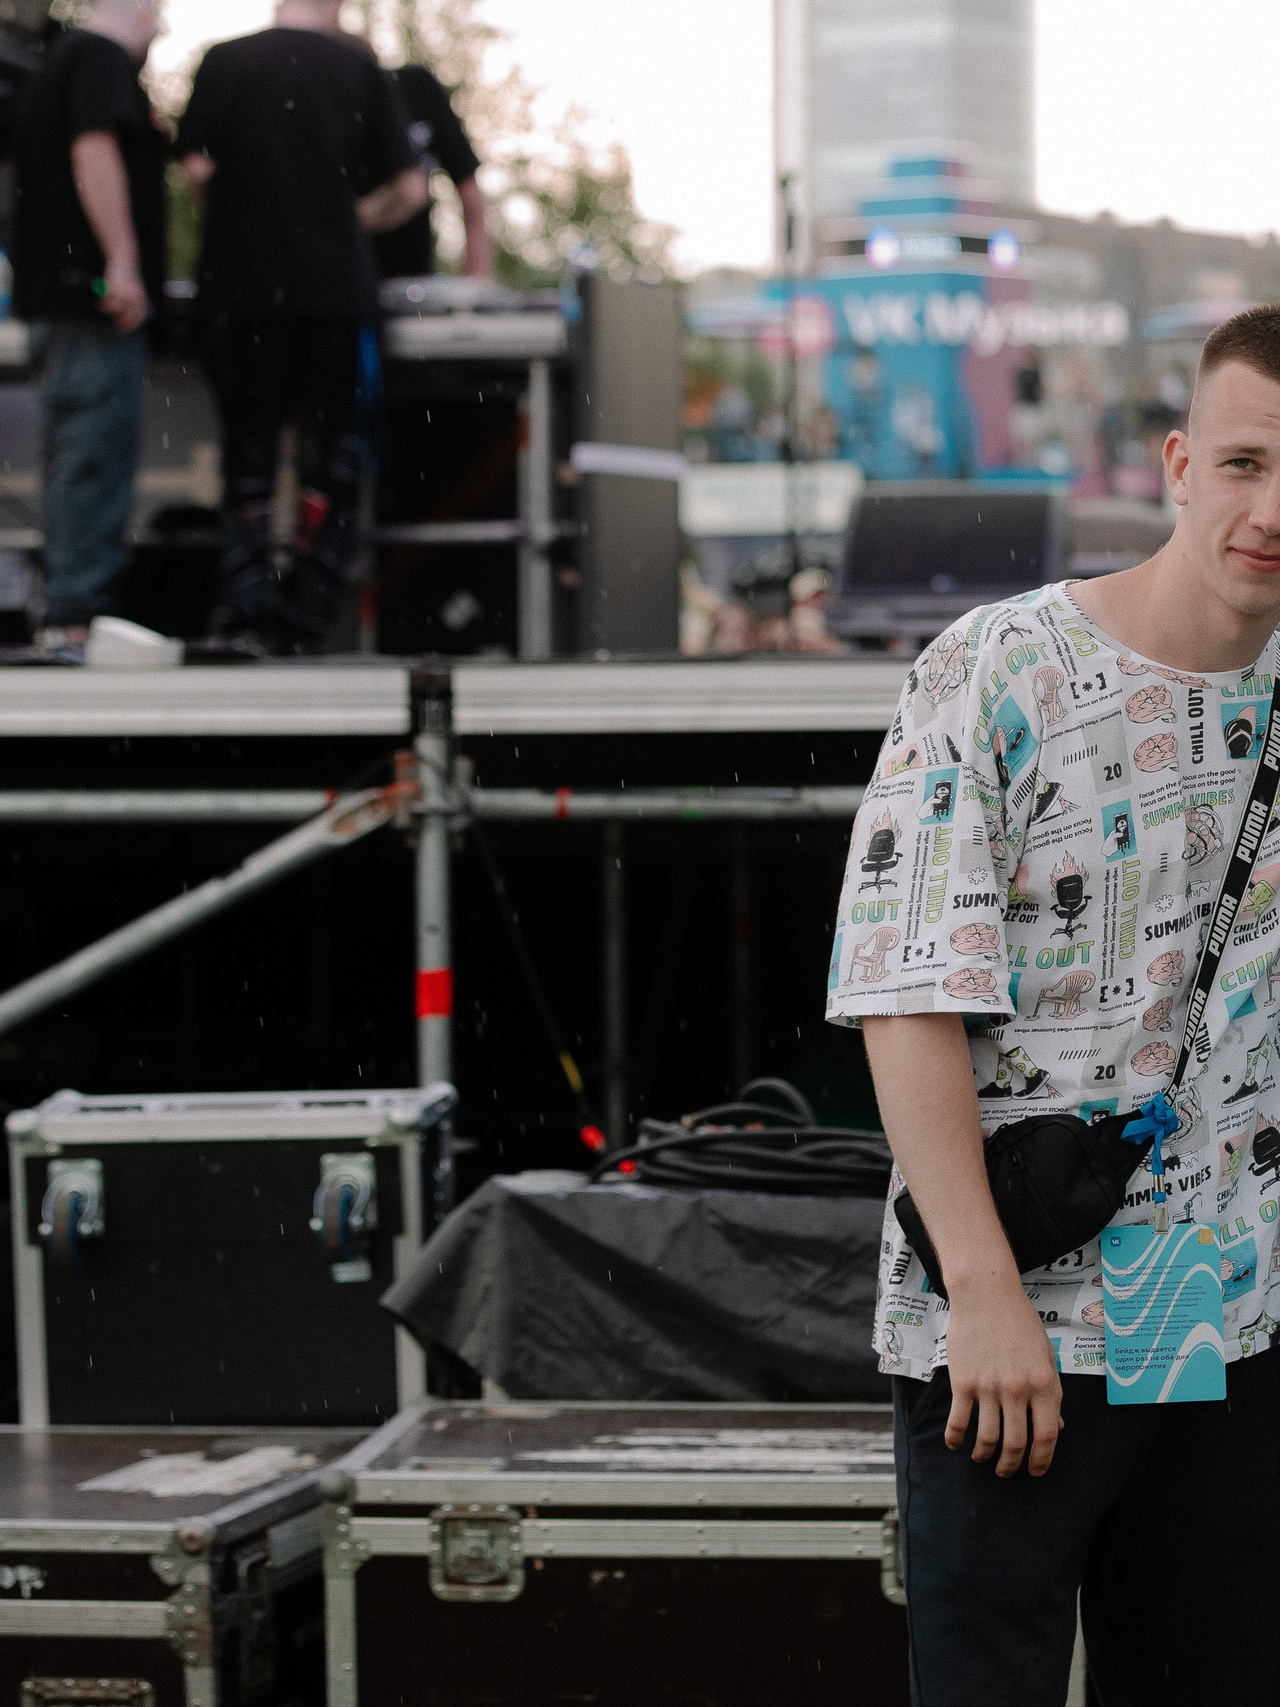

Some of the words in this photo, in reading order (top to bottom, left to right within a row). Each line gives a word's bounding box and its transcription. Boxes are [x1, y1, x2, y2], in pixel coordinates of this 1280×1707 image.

[1006, 642, 1051, 676] OUT
[1188, 687, 1204, 719] OUT
[1190, 721, 1204, 765] CHILL
[1104, 762, 1122, 782] 20
[1207, 770, 1218, 778] the
[1220, 768, 1236, 778] good
[1220, 777, 1236, 786] good
[1156, 785, 1164, 794] on
[1165, 781, 1177, 790] the
[1167, 790, 1179, 798] the
[1190, 788, 1236, 806] VIBES
[1236, 799, 1269, 864] PUMA
[932, 826, 953, 866] OUT
[1122, 860, 1141, 900] OUT
[924, 868, 948, 924] CHILL
[1023, 903, 1039, 912] OUT
[852, 899, 903, 924] OUT
[1019, 914, 1039, 924] OUT
[1261, 907, 1278, 924] OUT
[1119, 903, 1138, 960] CHILL
[1208, 893, 1238, 958] PUMA
[1233, 931, 1260, 947] CHILL
[1262, 918, 1280, 936] OUT
[1036, 940, 1095, 969] OUT
[1184, 987, 1207, 1052] PUMA
[1094, 1064, 1116, 1081] 20
[1178, 1165, 1212, 1192] VIBES
[1141, 1346, 1176, 1354] выдается
[1116, 1363, 1167, 1371] мероприятия
